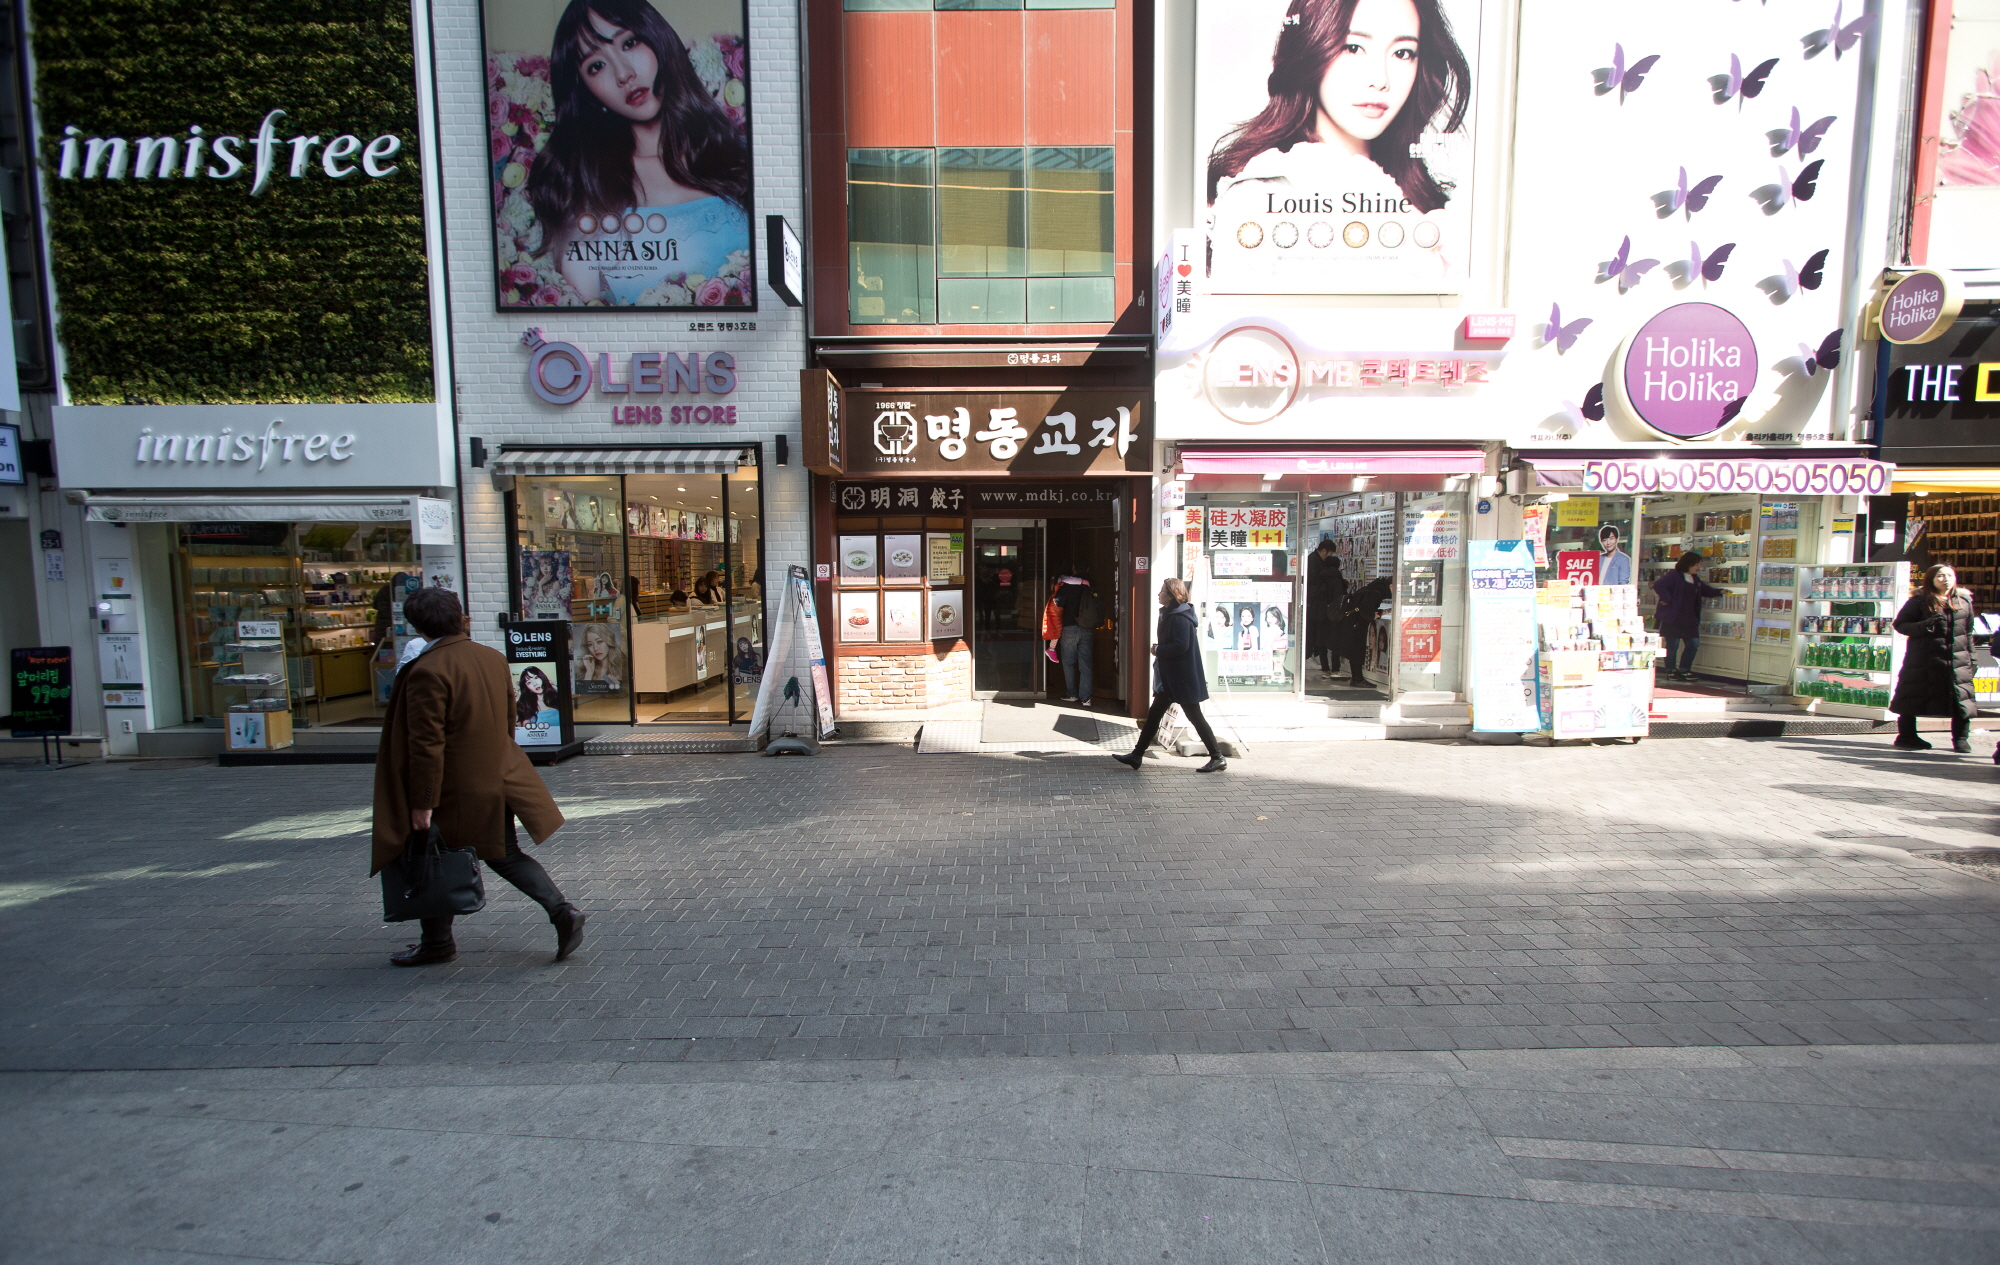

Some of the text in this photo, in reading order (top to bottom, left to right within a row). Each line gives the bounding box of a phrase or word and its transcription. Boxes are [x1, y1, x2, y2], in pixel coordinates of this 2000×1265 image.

[59, 109, 401, 197] innisfree
[1267, 192, 1412, 214] Louis Shine
[566, 239, 639, 261] ANNA
[1177, 280, 1191, 313] 美瞳
[1892, 288, 1939, 311] Holika
[689, 322, 757, 331] 오렌즈 명동3호점
[1890, 307, 1936, 328] Holika
[1020, 353, 1061, 364] 명동교자
[1646, 337, 1741, 367] Holika
[1214, 358, 1490, 389] LENS ME 콘택트렌즈
[1904, 364, 1963, 401] THE
[1644, 371, 1739, 401] Holika
[613, 405, 737, 424] LENS STORE
[876, 402, 895, 410] 1966
[924, 406, 1139, 461] 명동교자
[137, 420, 355, 472] innisfree
[980, 487, 1115, 504] www.mdkj.co.kr
[125, 511, 168, 520] innisfree
[1209, 509, 1287, 528] 硅水凝胶
[1210, 529, 1282, 548] 美瞳 1+1
[1405, 547, 1458, 559] 美瞳最低价
[1566, 558, 1594, 570] SALE
[1408, 579, 1436, 597] 1+1
[1473, 578, 1490, 589] 1+1
[1508, 578, 1534, 589] 260元
[1565, 571, 1593, 586] 50
[587, 602, 614, 617] 1+1
[1407, 636, 1434, 653] 1+1
